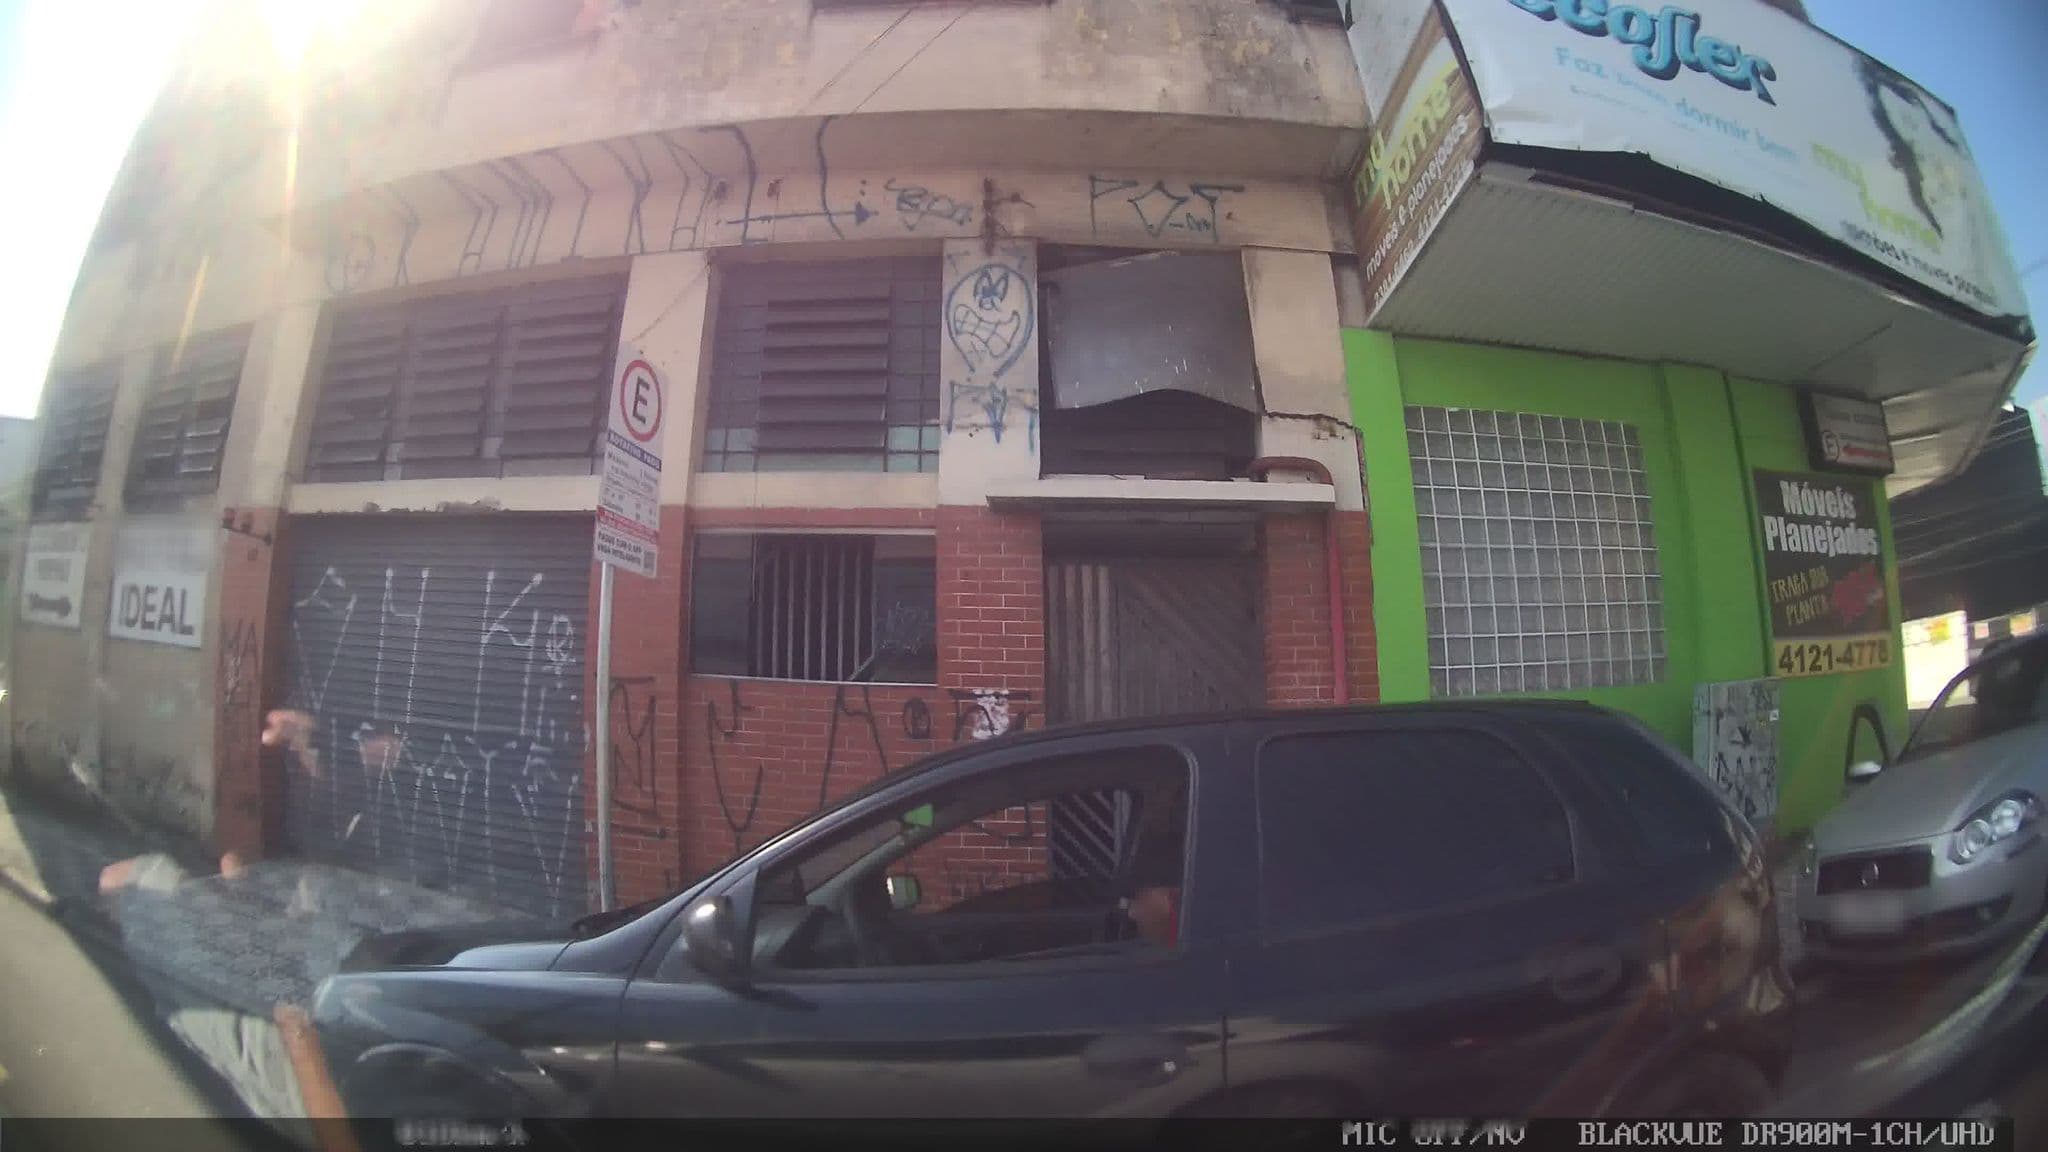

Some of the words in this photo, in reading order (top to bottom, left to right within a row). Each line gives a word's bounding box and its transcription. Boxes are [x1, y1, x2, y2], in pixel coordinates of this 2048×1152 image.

[632, 375, 650, 425] E
[1780, 480, 1856, 519] Móveis
[1764, 515, 1878, 557] Planejados
[119, 582, 195, 636] IDEAL
